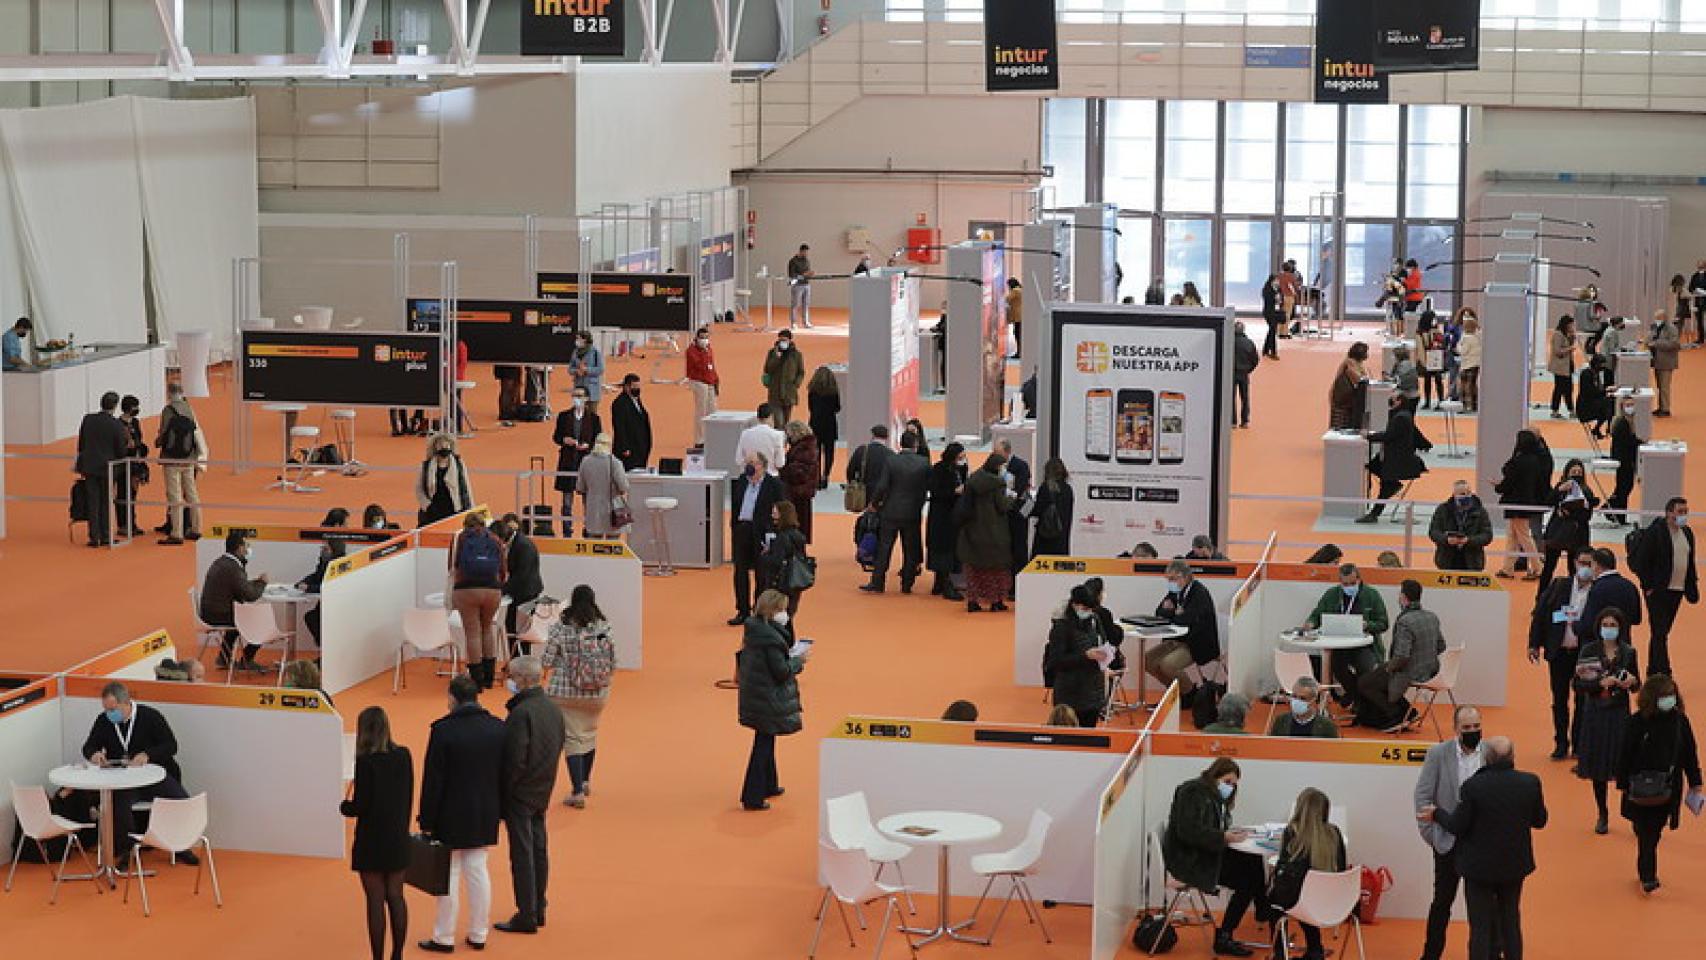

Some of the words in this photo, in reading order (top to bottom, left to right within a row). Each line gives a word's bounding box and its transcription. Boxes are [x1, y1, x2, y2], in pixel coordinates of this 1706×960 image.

[534, 0, 611, 15] intur
[574, 17, 610, 33] B2B
[995, 45, 1049, 63] intur
[995, 64, 1050, 78] negocios
[1324, 79, 1379, 92] negocios
[391, 347, 428, 361] intur
[1112, 345, 1180, 359] DESCARGA
[405, 361, 427, 372] plus
[1112, 359, 1171, 372] NUESTRA
[1173, 361, 1200, 373] APP
[1035, 560, 1049, 571] 34
[1437, 575, 1452, 585] 47
[845, 721, 863, 735] 36
[1381, 747, 1401, 761] 45
